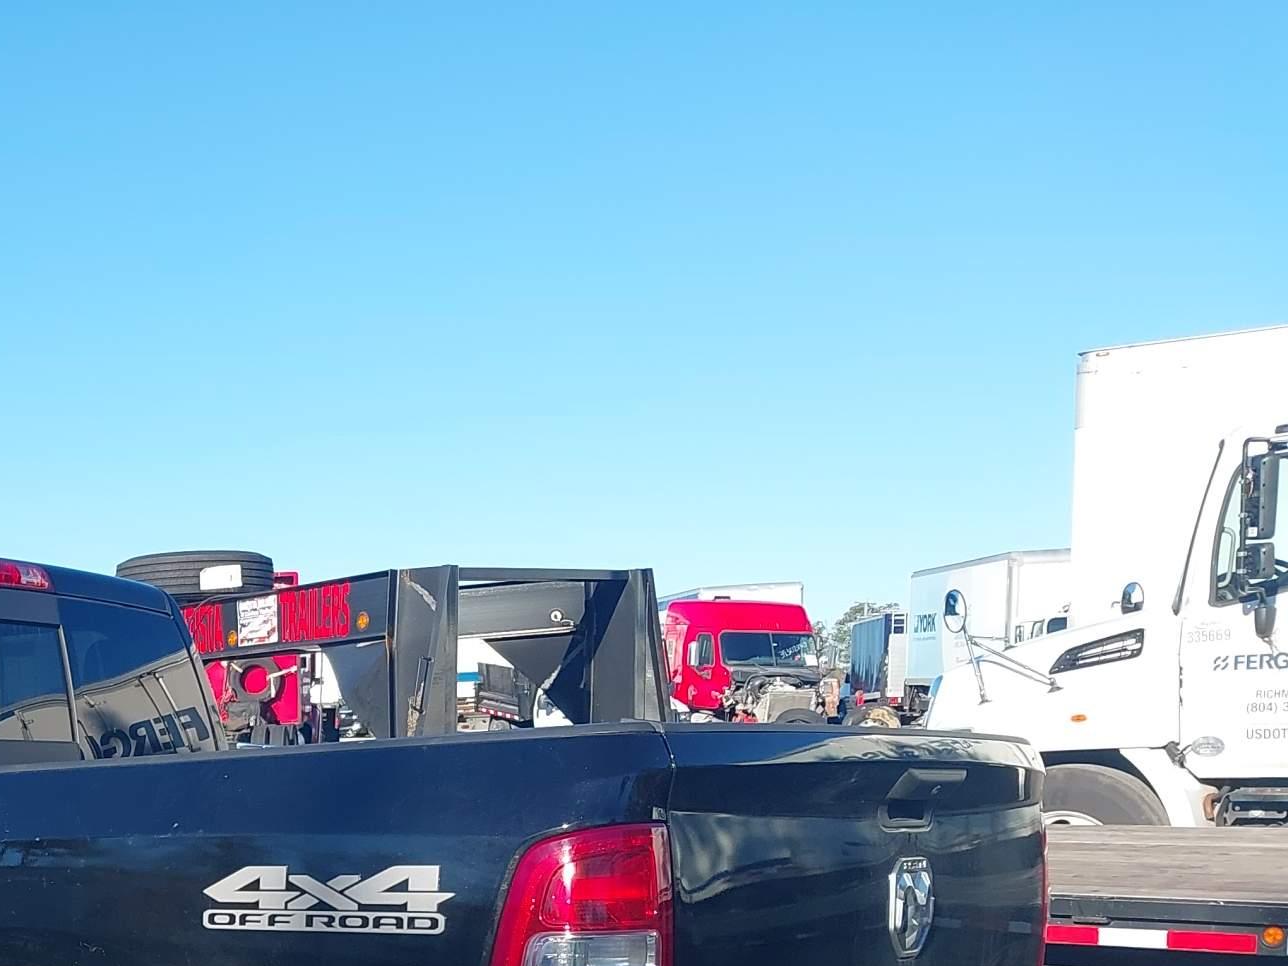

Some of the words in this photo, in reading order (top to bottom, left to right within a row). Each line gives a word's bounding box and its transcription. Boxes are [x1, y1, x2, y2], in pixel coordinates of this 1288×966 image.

[279, 582, 351, 642] TRAILERS
[920, 612, 937, 633] YORK
[1246, 701, 1278, 714] (804)
[1246, 727, 1288, 740] USDOT
[207, 911, 297, 928] OFF
[304, 913, 440, 931] ROAD
